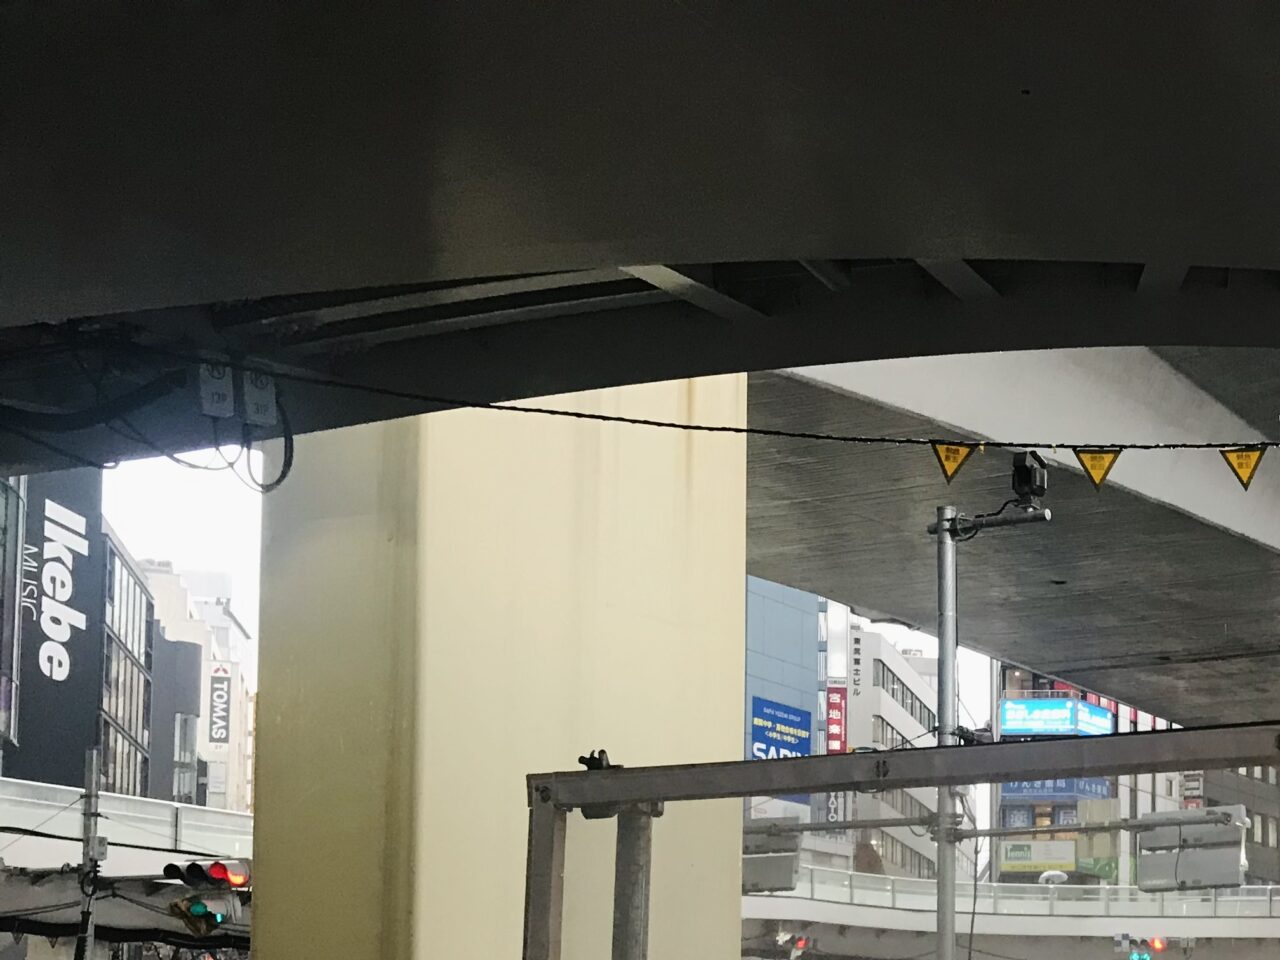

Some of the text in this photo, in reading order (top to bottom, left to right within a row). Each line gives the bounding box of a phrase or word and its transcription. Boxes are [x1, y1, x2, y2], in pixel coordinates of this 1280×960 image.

[21, 544, 39, 621] MUSIC
[38, 498, 90, 683] Ikebe
[211, 680, 228, 739] TOMAS
